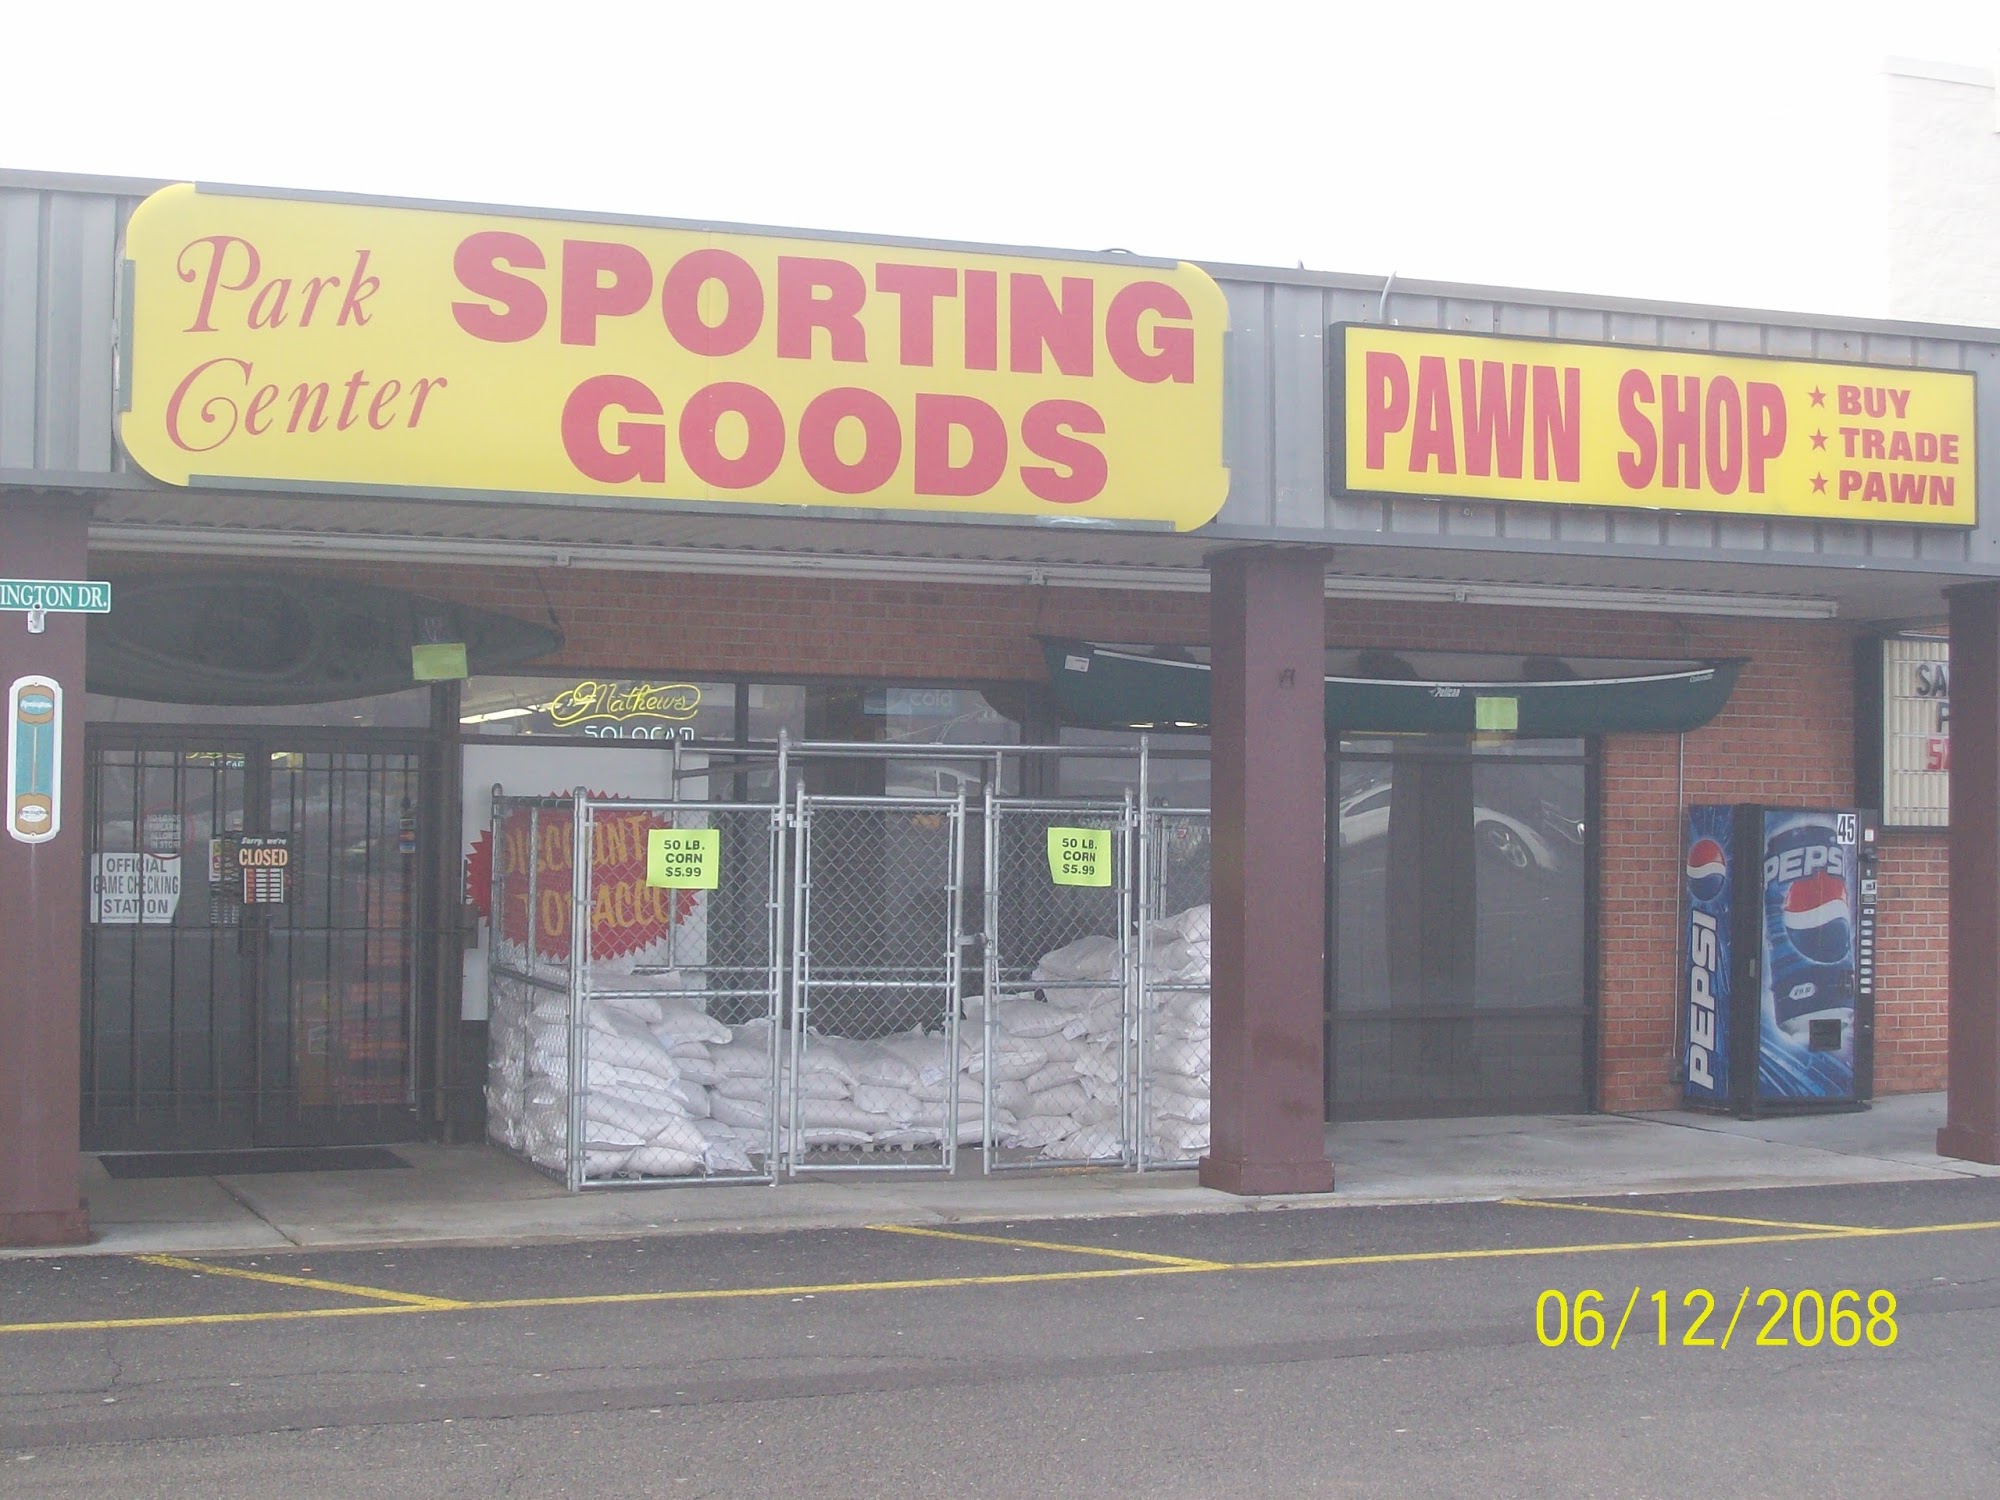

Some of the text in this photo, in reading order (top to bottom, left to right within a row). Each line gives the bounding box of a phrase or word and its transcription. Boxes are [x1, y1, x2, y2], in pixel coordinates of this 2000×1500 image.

[176, 235, 380, 332] Park
[451, 231, 1194, 384] SPORTING
[165, 357, 447, 452] Center
[1838, 385, 1911, 419] BUY
[561, 374, 1108, 503] GOODS
[1366, 351, 1787, 495] PAWN SHOP
[1839, 427, 1960, 465] TRADE
[1839, 470, 1955, 507] PAWN
[78, 586, 107, 607] DR.
[1917, 664, 1949, 697] SA
[550, 681, 700, 721] Mathews
[664, 840, 705, 850] 50 LB.
[1062, 838, 1097, 850] 50 LB.
[1838, 816, 1855, 842] 45
[239, 848, 288, 866] CLOSED
[665, 853, 703, 864] CORN
[665, 866, 702, 877] $5.99
[1062, 863, 1095, 876] $5.99
[1063, 850, 1096, 862] CORN
[1689, 909, 1717, 1090] PEPSI
